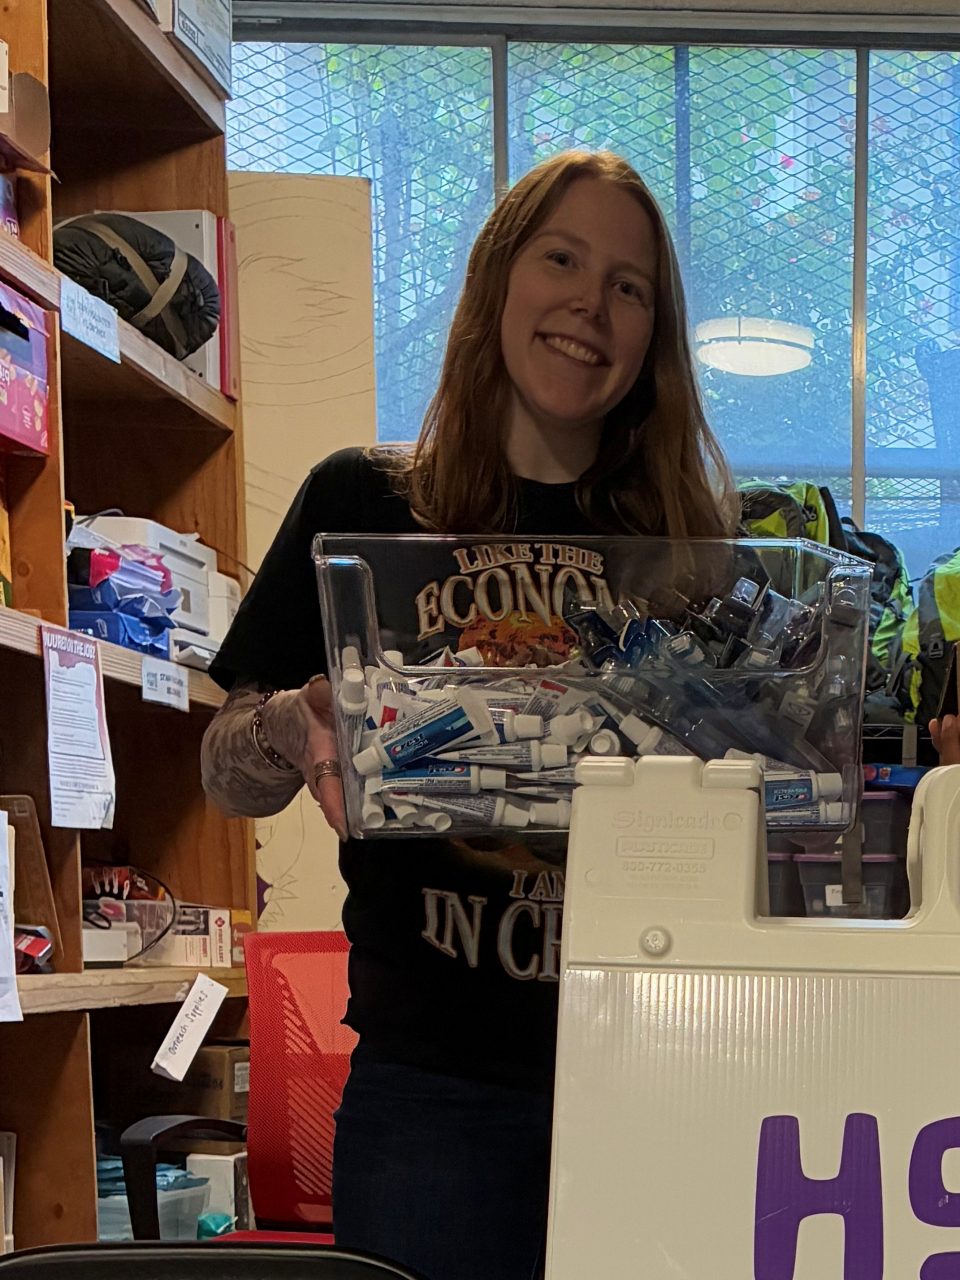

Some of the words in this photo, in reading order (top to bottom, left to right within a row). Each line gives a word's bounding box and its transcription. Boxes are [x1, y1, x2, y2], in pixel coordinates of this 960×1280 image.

[453, 544, 534, 574] LIKE
[535, 543, 604, 575] THE
[508, 869, 529, 899] I
[421, 887, 488, 969] IN
